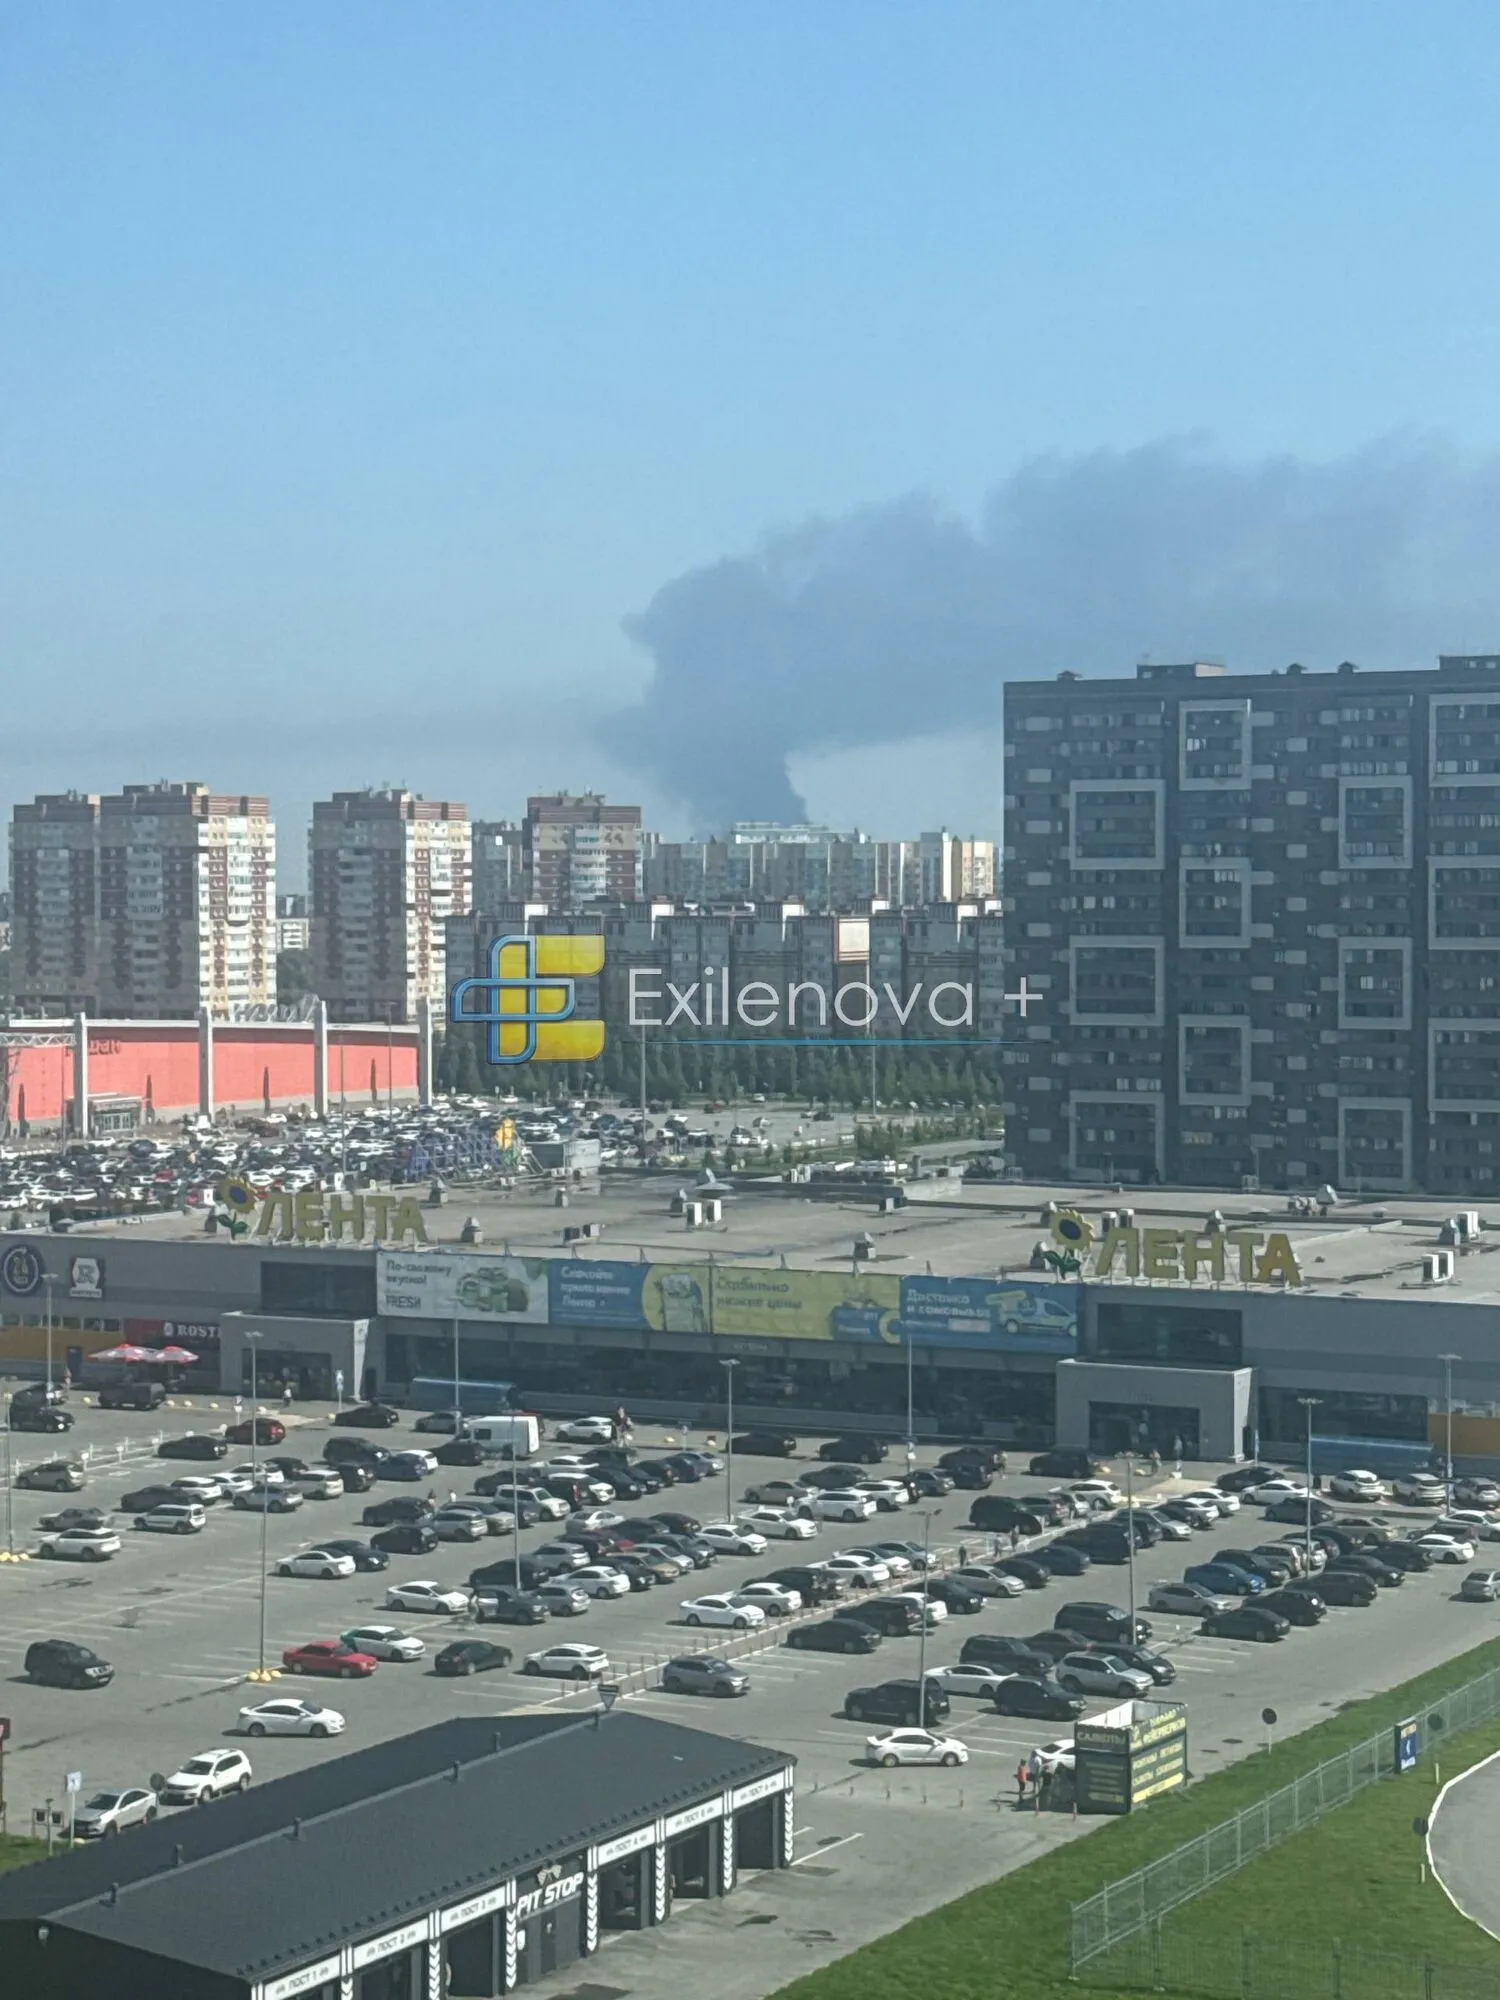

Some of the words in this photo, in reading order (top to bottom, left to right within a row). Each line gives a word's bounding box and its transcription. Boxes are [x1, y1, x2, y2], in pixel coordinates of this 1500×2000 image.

[257, 1191, 428, 1242] ЛЕНТА
[1095, 1228, 1302, 1286] ЛЕНТА
[385, 1295, 422, 1309] FRESH
[516, 1888, 543, 1918] PIT
[543, 1871, 585, 1906] STOP
[460, 1903, 480, 1919] ПОСТ
[377, 1936, 398, 1952] ПОСТ
[288, 1973, 310, 1990] ПОСТ
